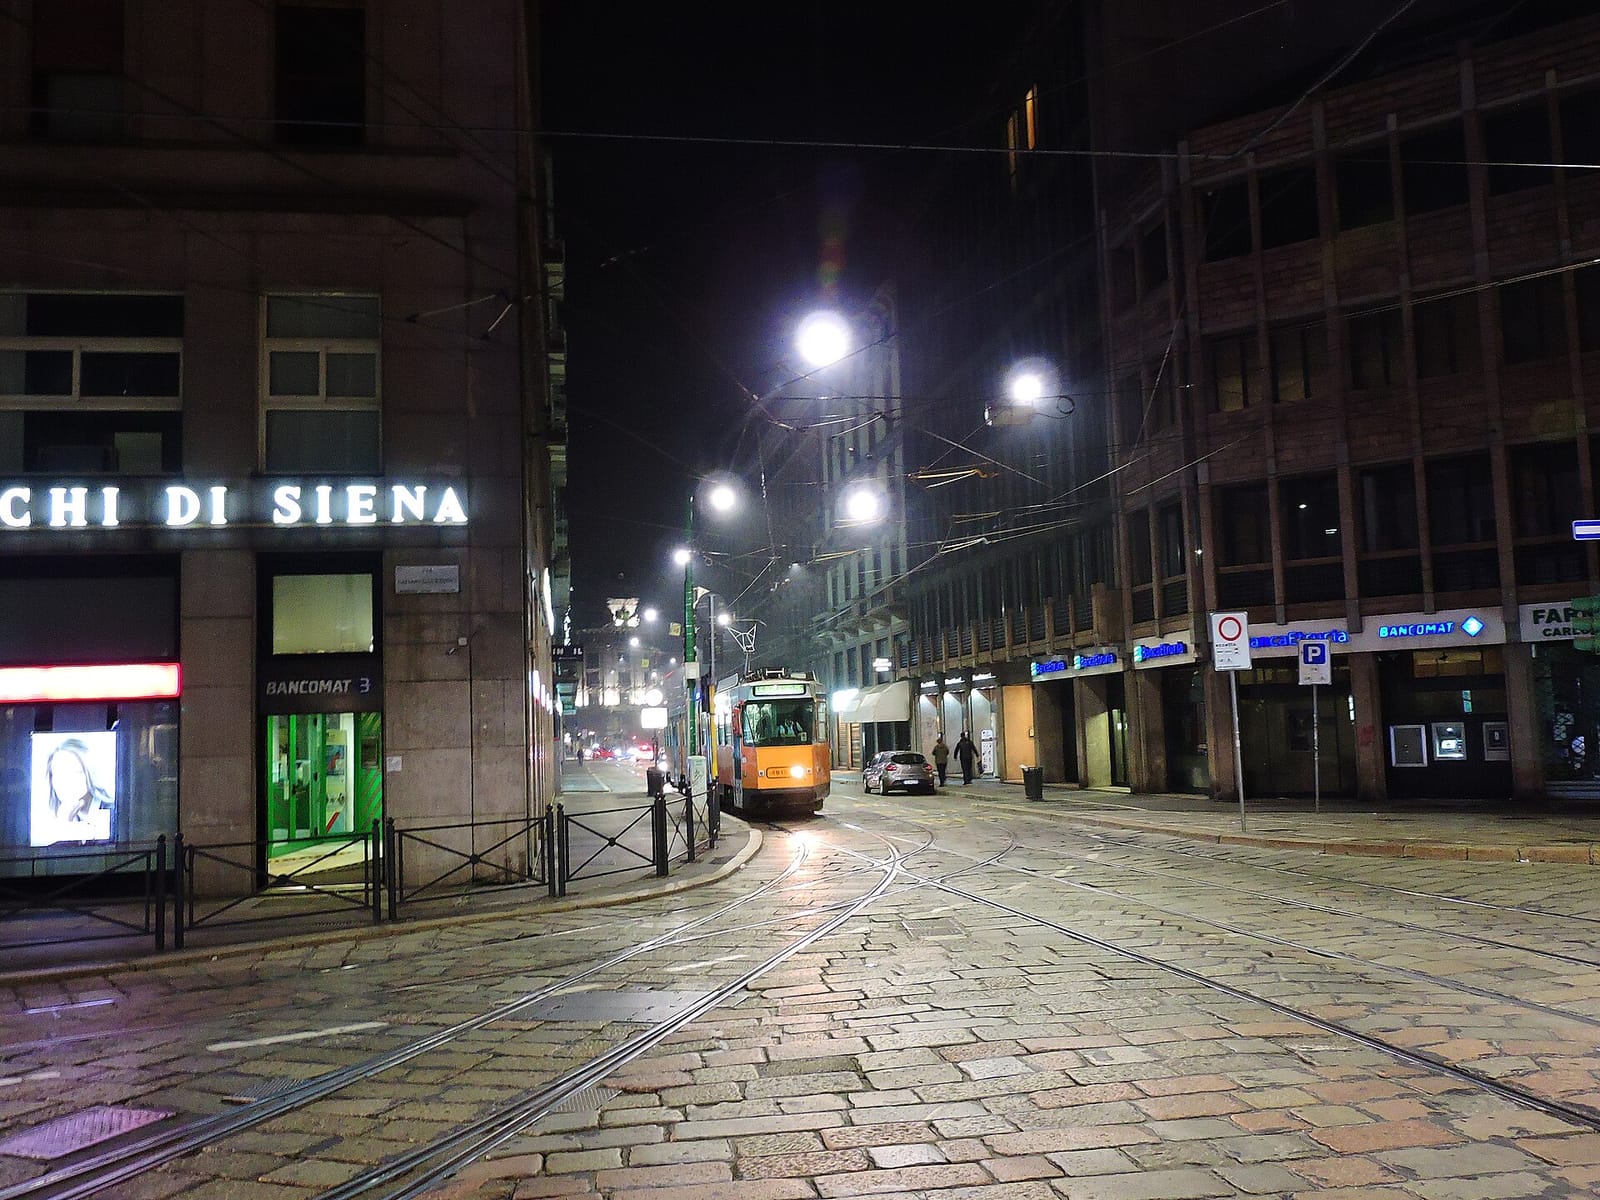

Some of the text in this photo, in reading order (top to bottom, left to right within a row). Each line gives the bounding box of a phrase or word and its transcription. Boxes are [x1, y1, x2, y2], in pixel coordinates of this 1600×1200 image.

[0, 485, 469, 527] CHI DI SIENA
[1379, 621, 1455, 638] BANCOMAT
[266, 679, 352, 695] BANCOMAT
